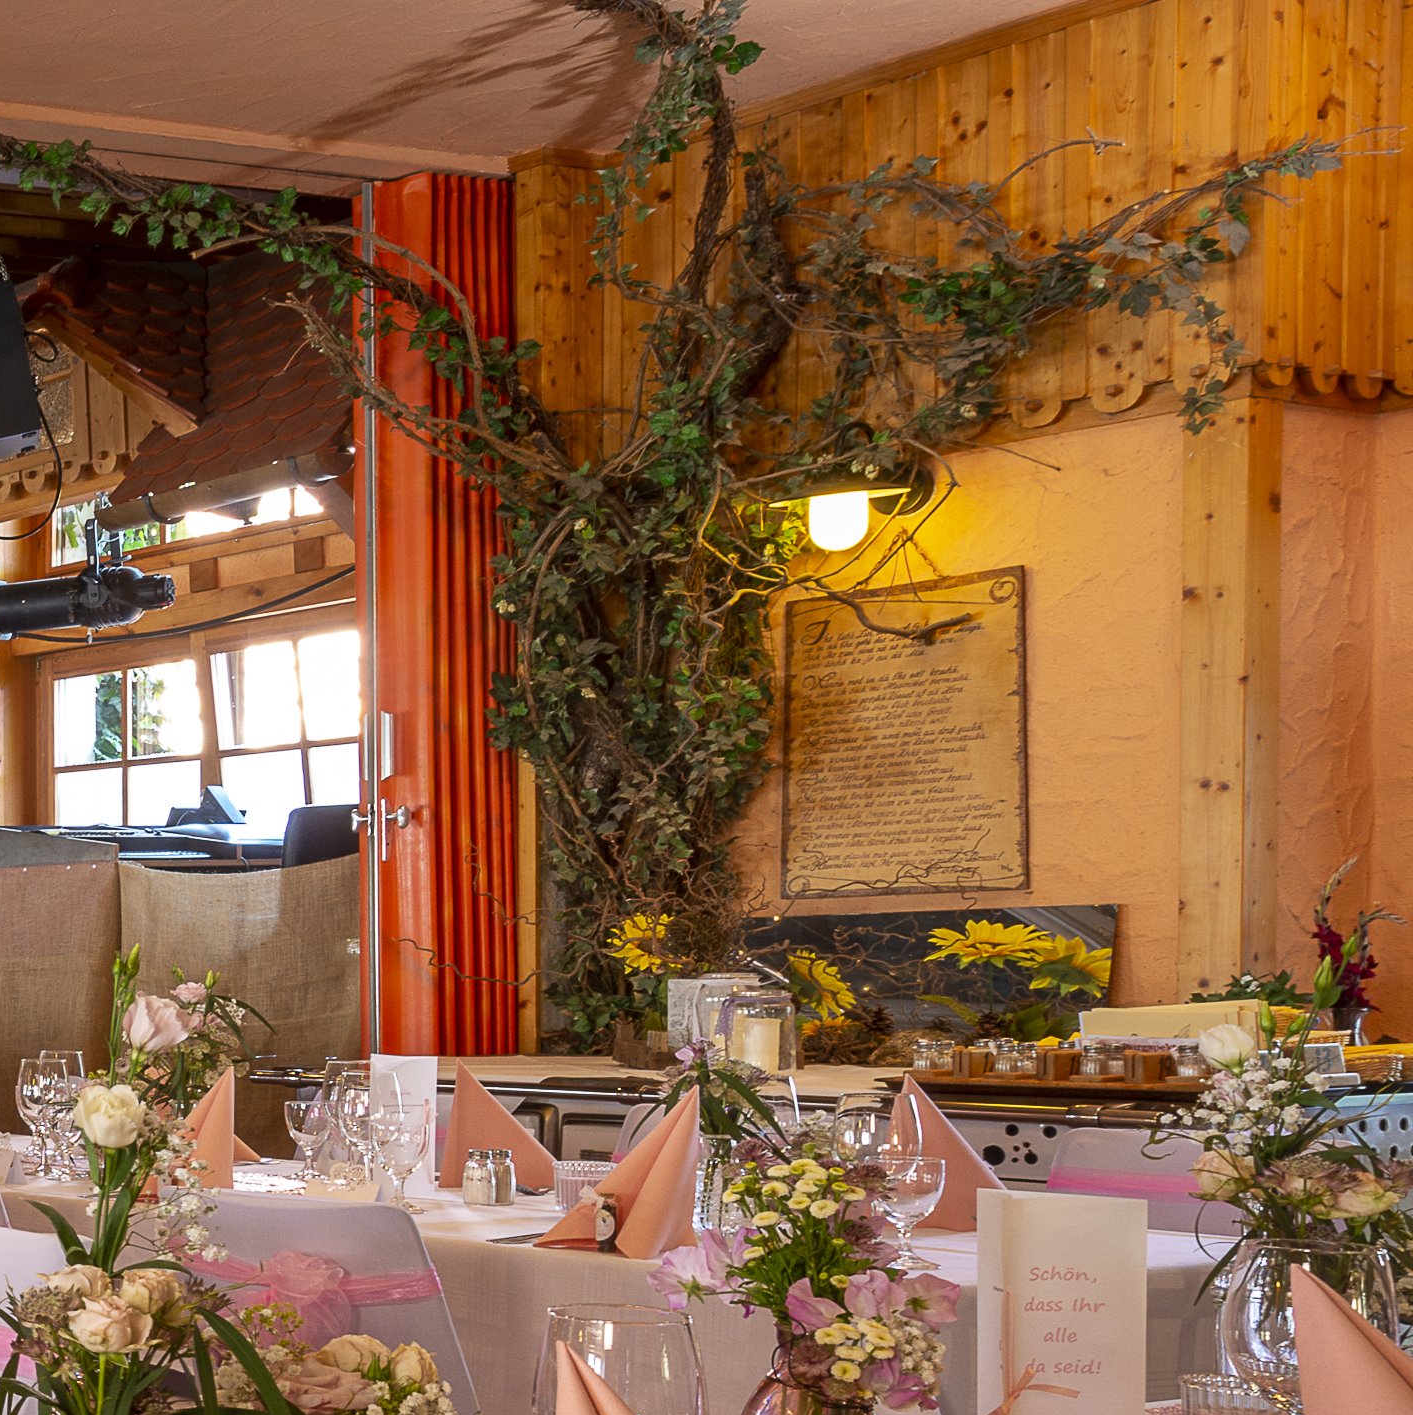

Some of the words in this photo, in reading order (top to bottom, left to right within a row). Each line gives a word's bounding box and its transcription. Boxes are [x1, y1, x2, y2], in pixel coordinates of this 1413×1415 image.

[1029, 1265, 1098, 1285] Schön,
[1023, 1296, 1063, 1313] dass
[1071, 1297, 1107, 1314] Ihr
[1043, 1327, 1078, 1344] alle
[1026, 1358, 1047, 1375] da
[1053, 1359, 1103, 1375] seid!
